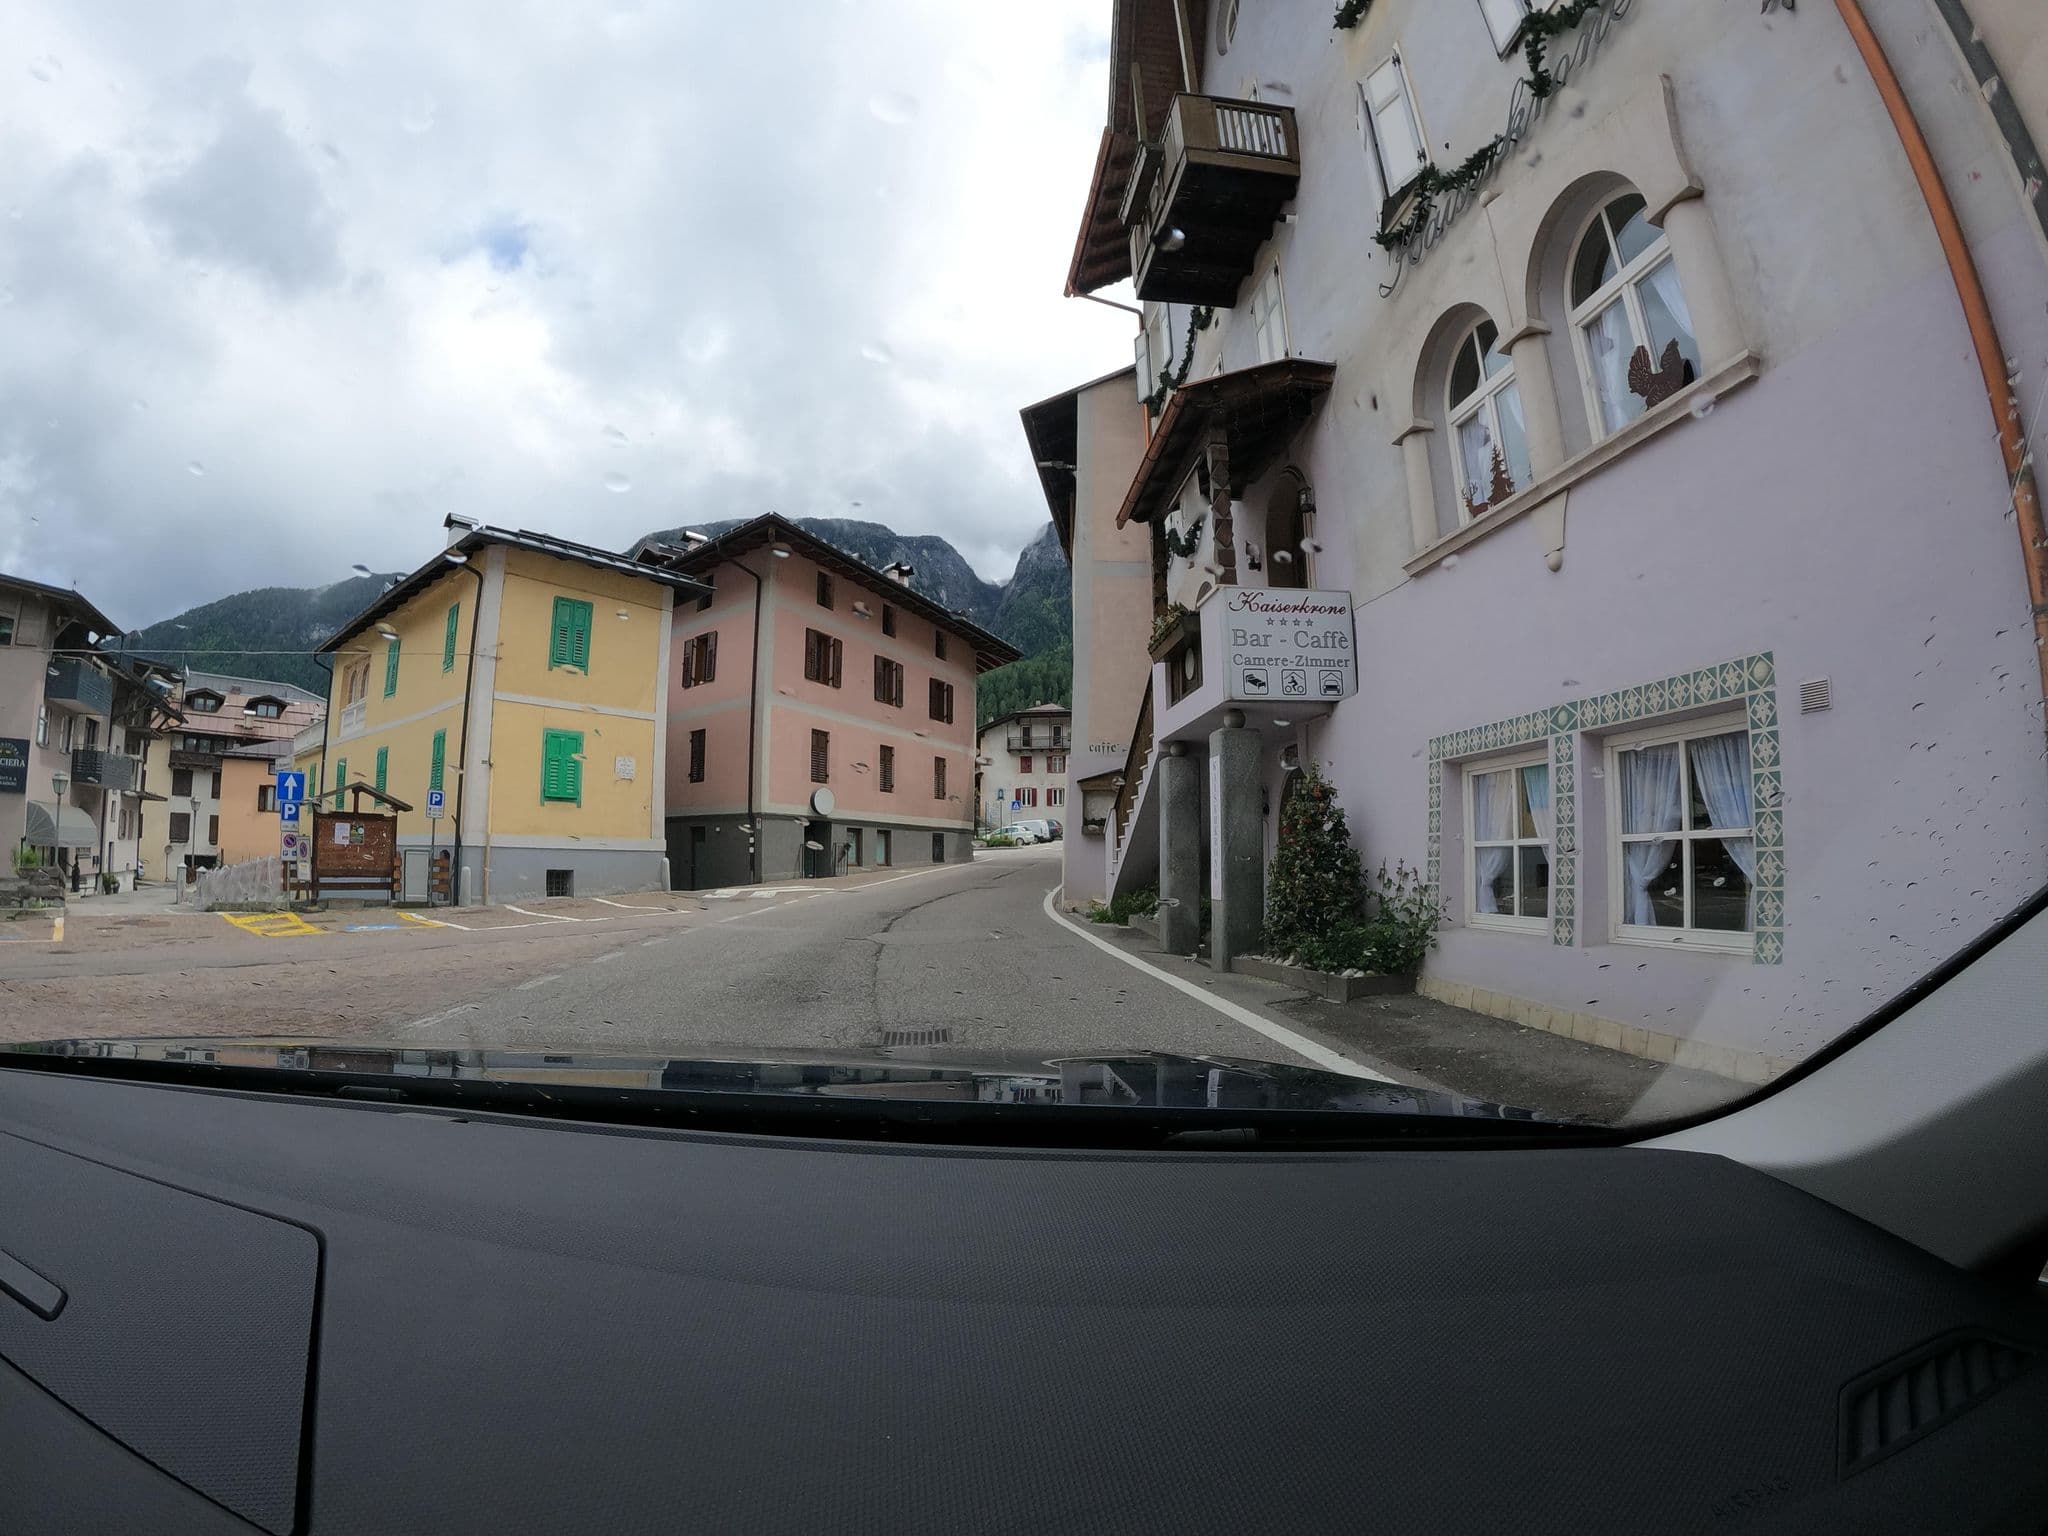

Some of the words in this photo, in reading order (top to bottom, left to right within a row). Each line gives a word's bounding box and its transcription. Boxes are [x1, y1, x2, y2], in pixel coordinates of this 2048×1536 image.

[1228, 591, 1347, 615] Kaiserkrone
[1231, 628, 1273, 647] Bar
[1293, 630, 1349, 650] Caffè
[1232, 653, 1351, 668] Camere-Zimmer
[432, 793, 441, 805] P
[283, 803, 296, 820] P
